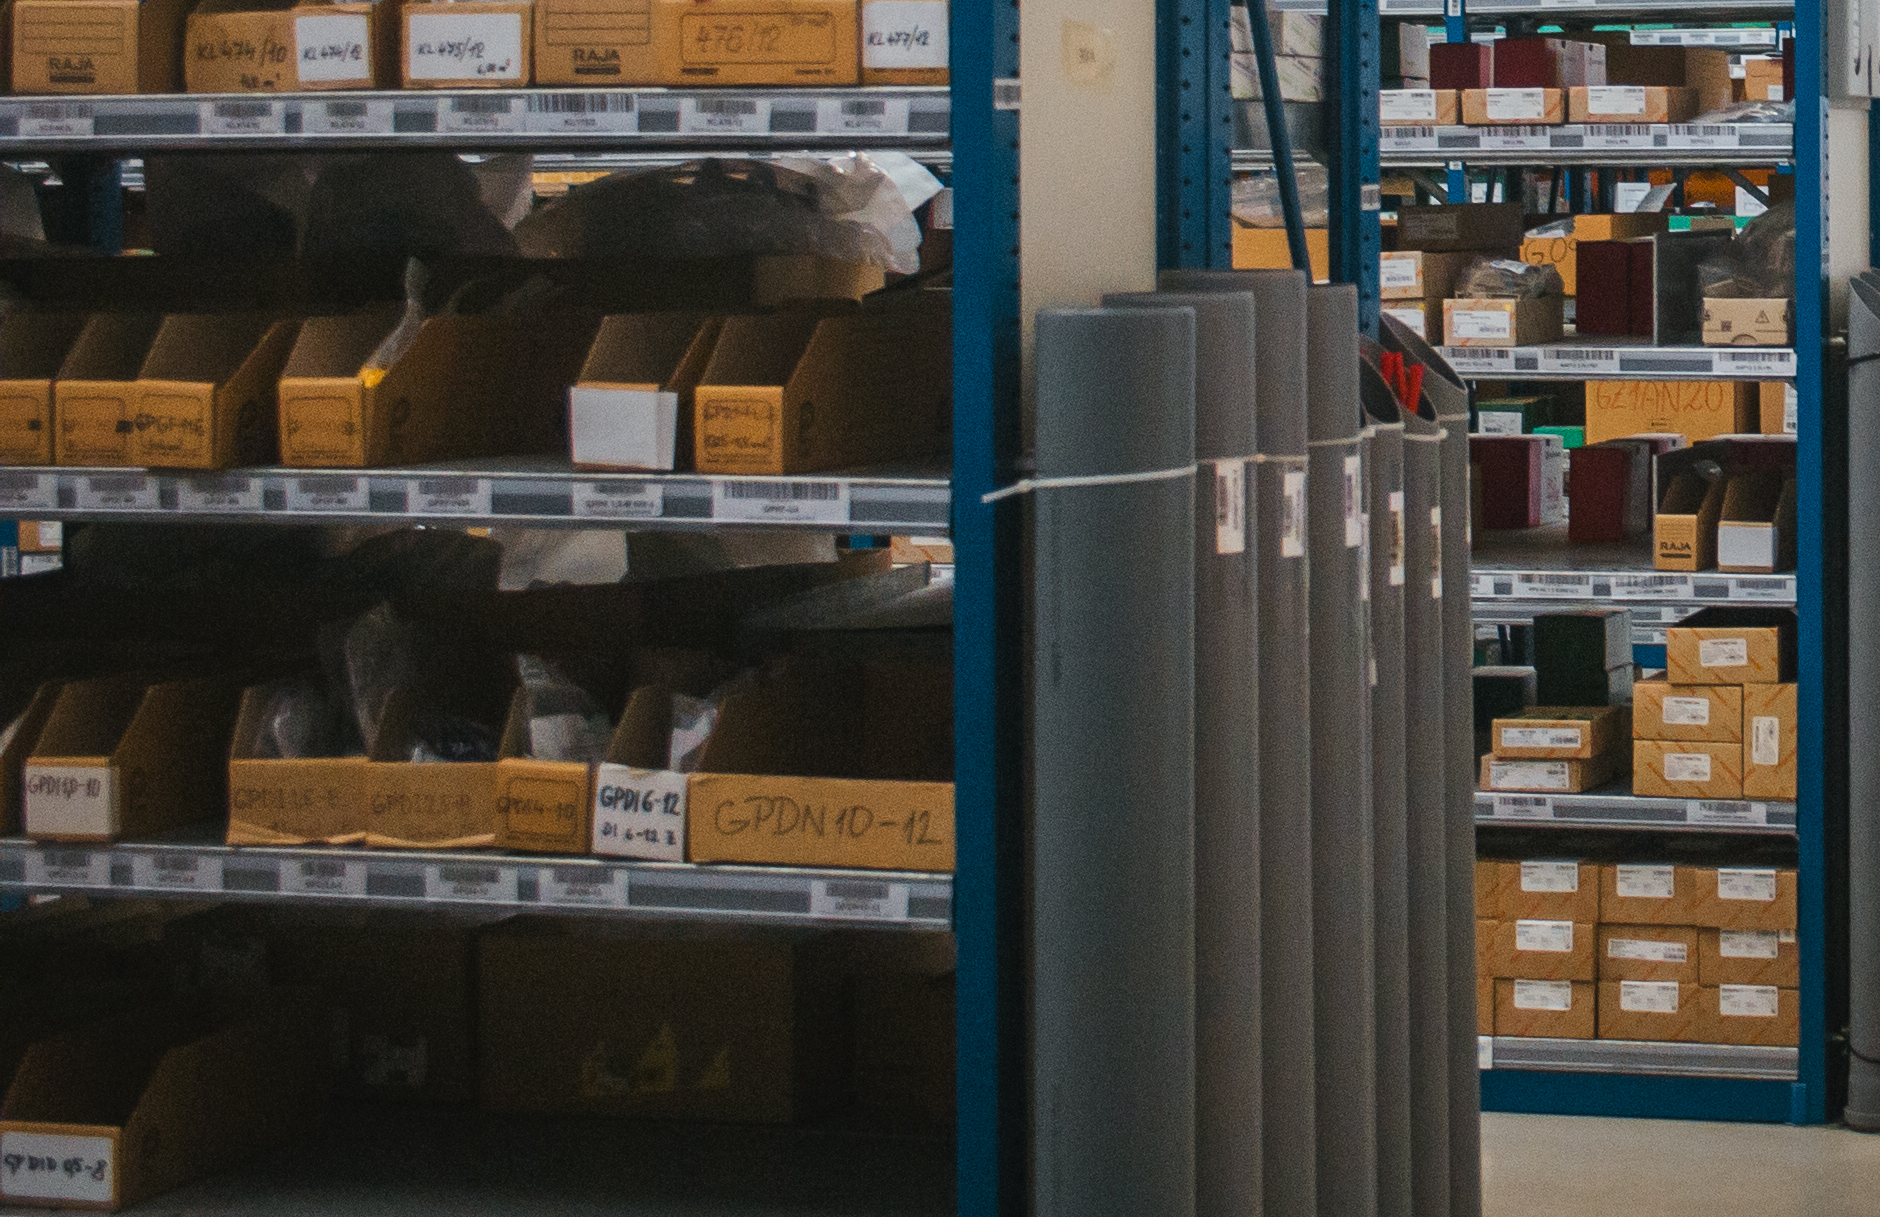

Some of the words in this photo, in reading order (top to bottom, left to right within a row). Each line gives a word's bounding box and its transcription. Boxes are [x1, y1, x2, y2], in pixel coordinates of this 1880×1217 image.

[573, 49, 620, 63] RAJA
[49, 58, 95, 71] RAJA
[1660, 542, 1691, 551] RAJA
